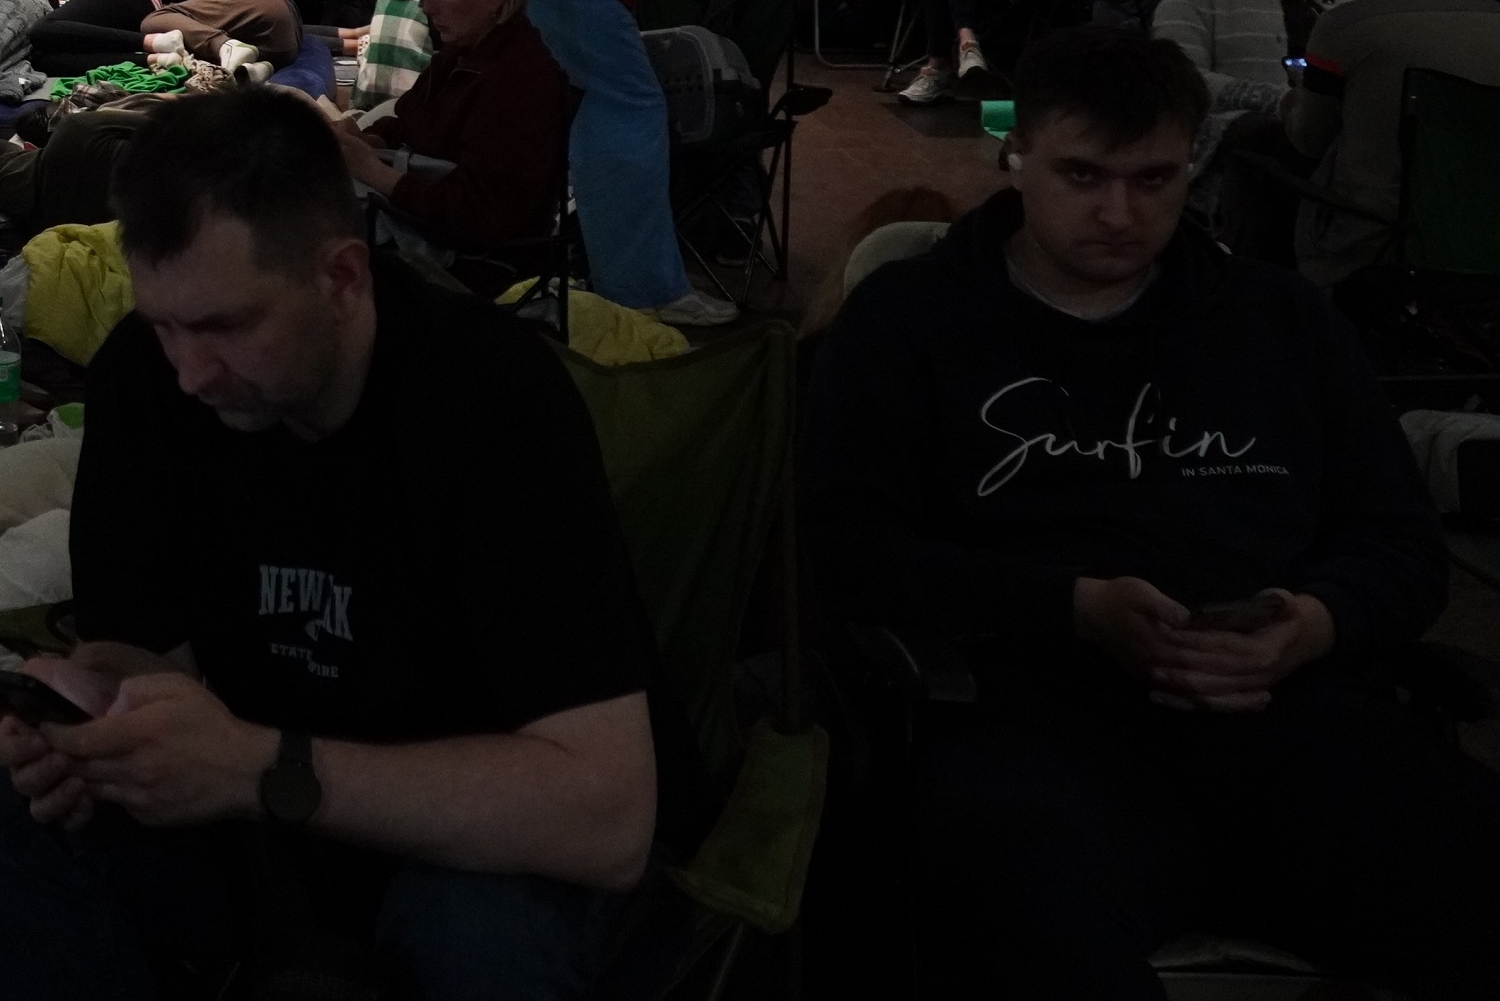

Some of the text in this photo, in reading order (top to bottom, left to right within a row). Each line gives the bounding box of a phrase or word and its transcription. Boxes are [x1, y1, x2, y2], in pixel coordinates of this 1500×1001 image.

[976, 376, 1257, 497] Surfin
[1182, 464, 1290, 477] IN SANTA MONICA
